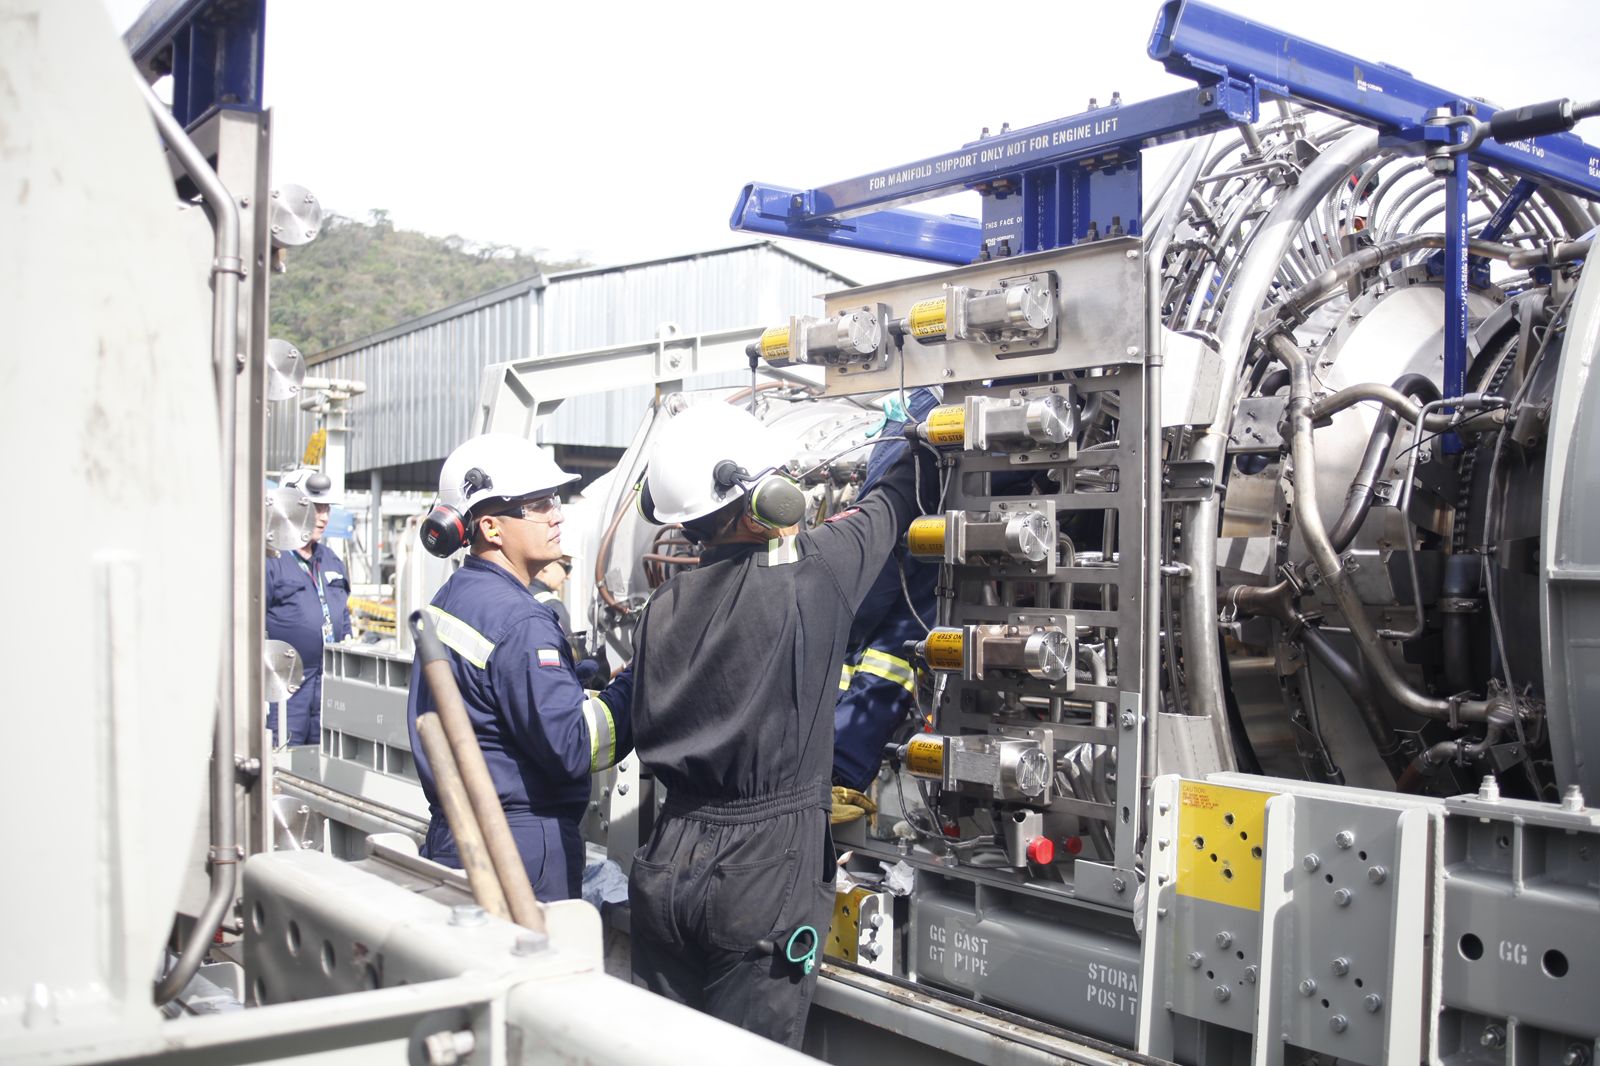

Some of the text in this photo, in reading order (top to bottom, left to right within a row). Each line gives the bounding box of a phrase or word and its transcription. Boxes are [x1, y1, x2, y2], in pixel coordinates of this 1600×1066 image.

[869, 118, 1118, 191] FOR MANIFOLD SUPPORT ONLY NOT FOR ENGINE LIFT
[985, 221, 998, 230] THIS
[999, 217, 1014, 227] FACE
[949, 434, 963, 442] STEP
[929, 924, 988, 956] GG CAST
[1499, 940, 1528, 966] GG
[929, 945, 988, 977] GT PIPE
[1088, 962, 1138, 993] STORA
[1086, 984, 1138, 1016] POSIT
